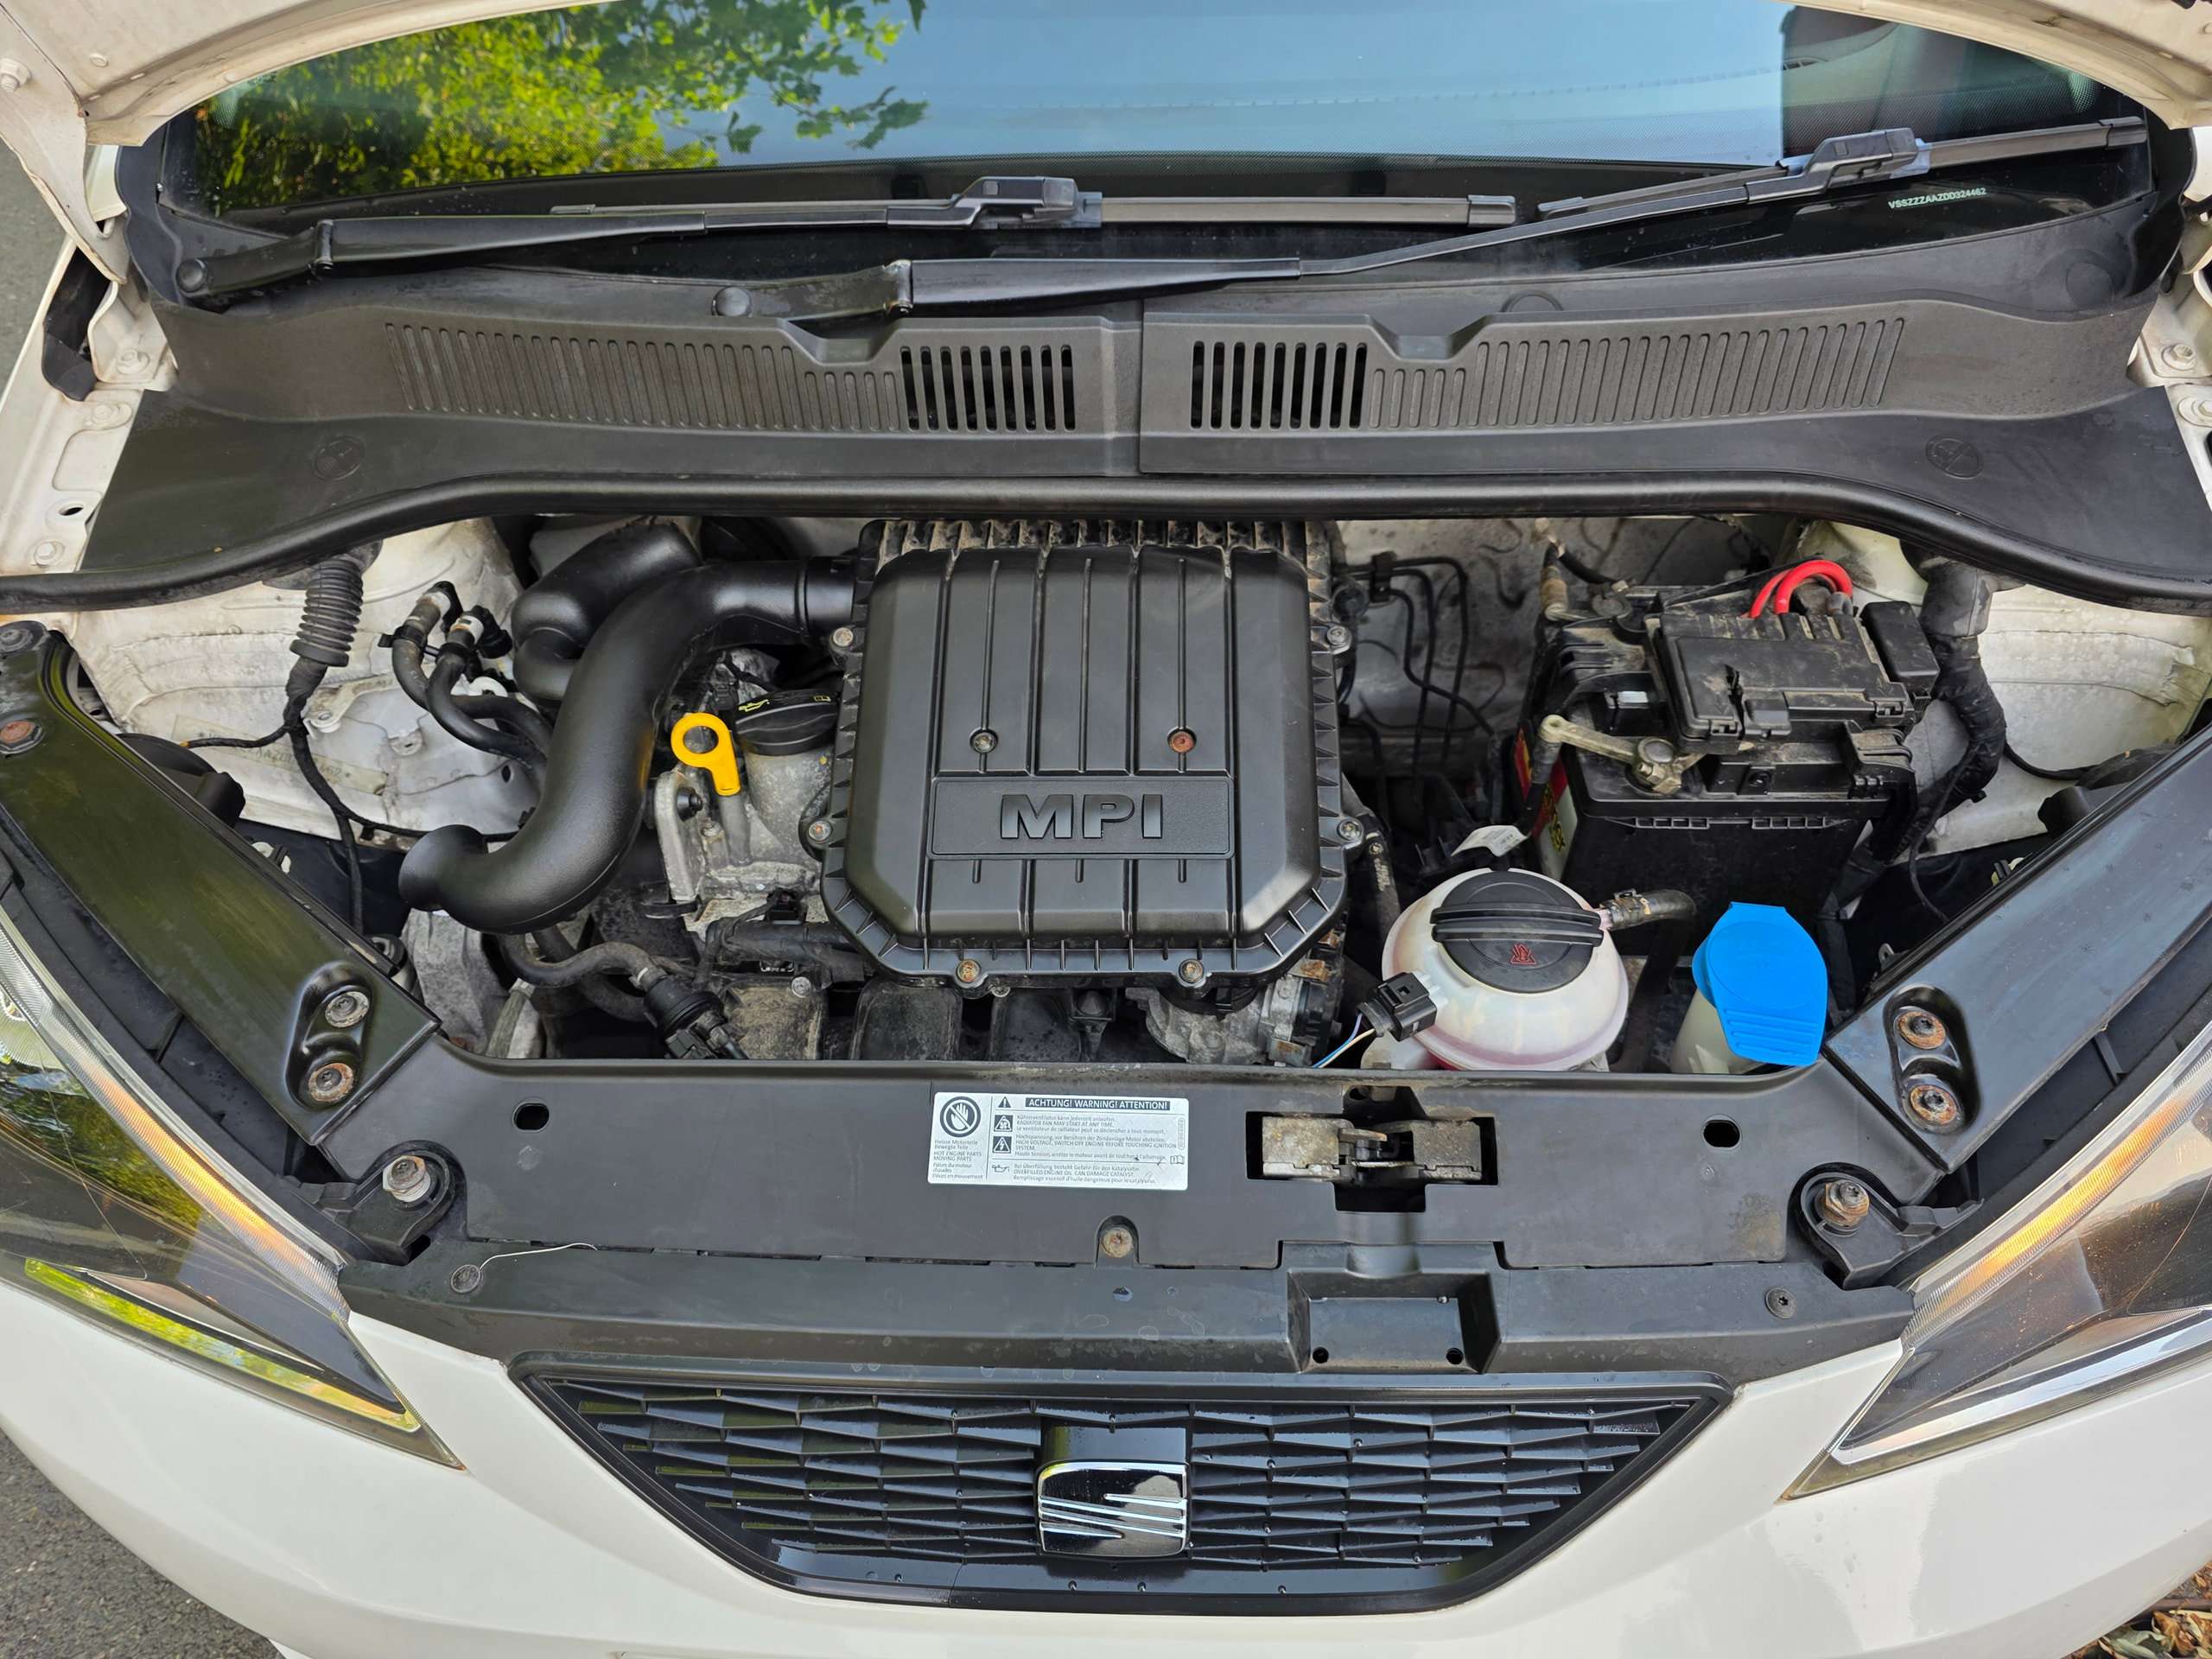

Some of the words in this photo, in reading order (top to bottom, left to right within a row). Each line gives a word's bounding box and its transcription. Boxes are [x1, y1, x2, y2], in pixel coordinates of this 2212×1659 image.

[1001, 794, 1163, 839] MPI
[1028, 1098, 1071, 1107] ACHTUNG!
[1074, 1099, 1116, 1108] WARNING!
[1119, 1100, 1166, 1109] ATTENTION!
